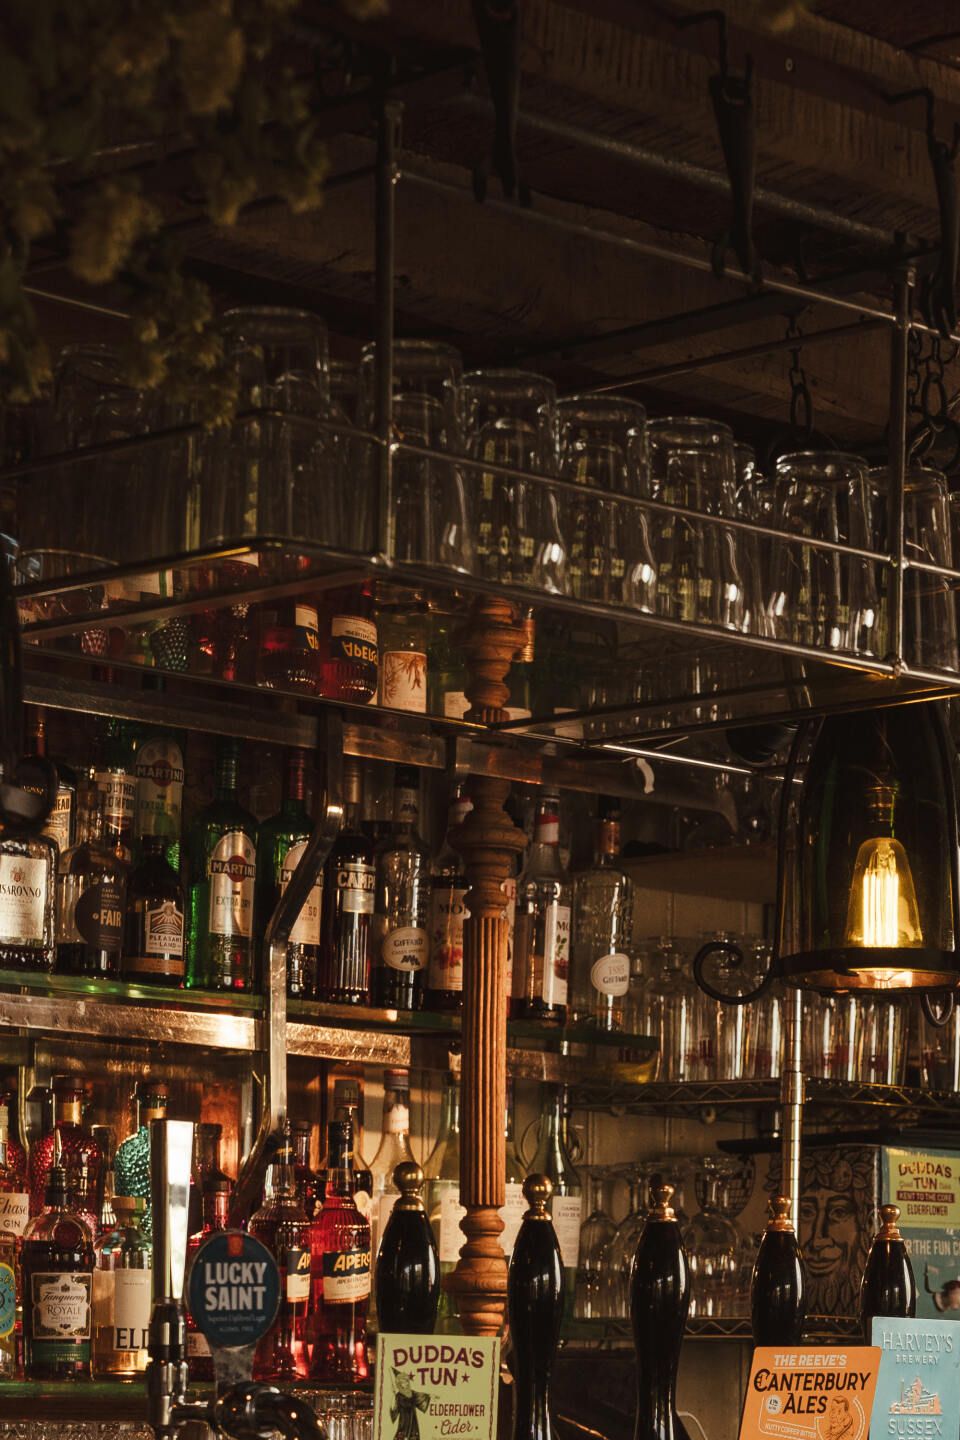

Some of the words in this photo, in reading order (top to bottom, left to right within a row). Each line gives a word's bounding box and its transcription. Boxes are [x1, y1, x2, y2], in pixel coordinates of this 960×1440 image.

[212, 862, 256, 877] MARTINI
[0, 884, 42, 898] ISARONNO
[100, 909, 122, 928] FAIR
[393, 937, 424, 948] GIFFARD
[899, 1162, 952, 1178] DUDDA'S
[913, 1177, 937, 1190] TUN
[3, 1219, 21, 1229] GIN
[914, 1239, 932, 1255] THE
[933, 1240, 951, 1256] FUN
[205, 1262, 267, 1285] LUCKY
[42, 1291, 86, 1304] Tanqueray
[205, 1286, 267, 1312] SAINT
[883, 1331, 954, 1353] HARVEY'S
[392, 1345, 486, 1369] DUDDA'S
[774, 1354, 798, 1367] THE
[798, 1354, 848, 1367] REEVE'S
[895, 1354, 940, 1365] BREWERY
[416, 1367, 459, 1387] TUN
[753, 1368, 872, 1393] CANTERBURY
[429, 1403, 486, 1417] ELDERFLOWER
[782, 1392, 829, 1415] ALES
[440, 1418, 473, 1436] Cider
[888, 1418, 943, 1436] SUSSEX
